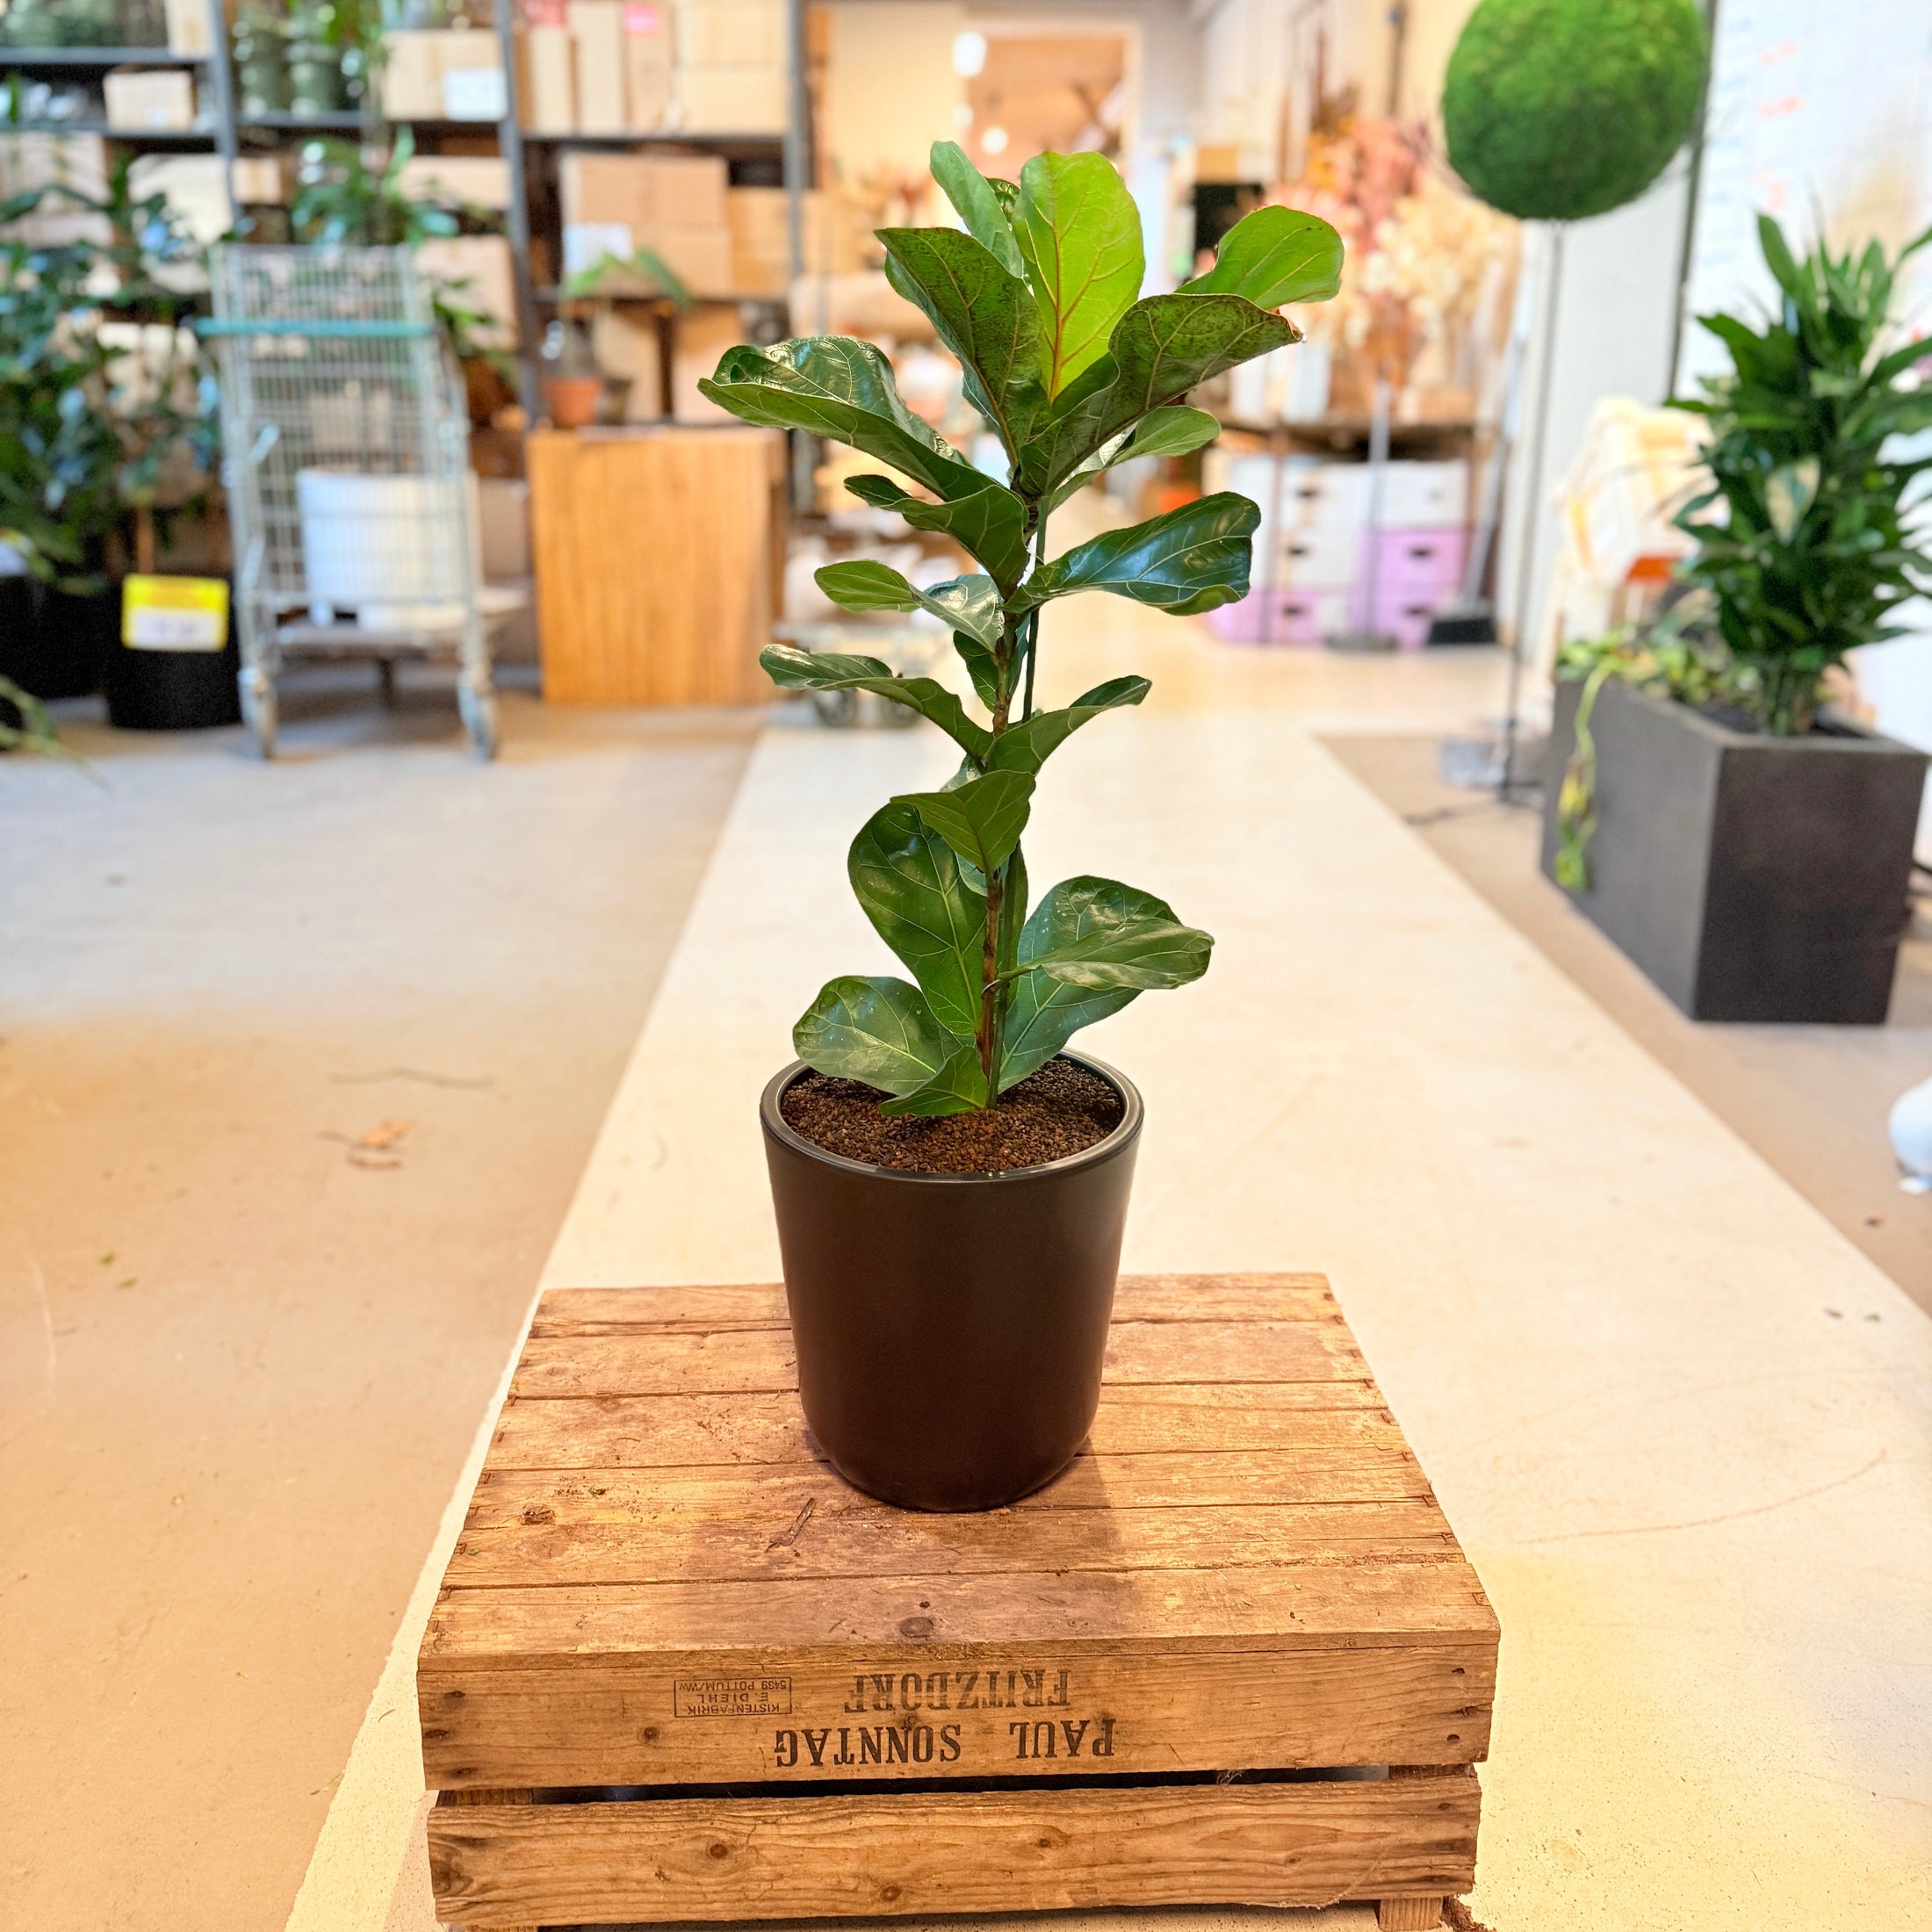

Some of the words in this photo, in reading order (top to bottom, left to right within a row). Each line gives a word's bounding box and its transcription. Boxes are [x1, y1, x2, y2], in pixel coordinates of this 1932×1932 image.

[696, 1692, 749, 1704] DIEHL
[761, 1680, 787, 1690] 5439
[843, 1669, 1072, 1713] FRITZDORF
[687, 1703, 781, 1715] KISTENFABRIK
[773, 1723, 962, 1767] SONNTAG
[1008, 1718, 1117, 1759] PAUL
